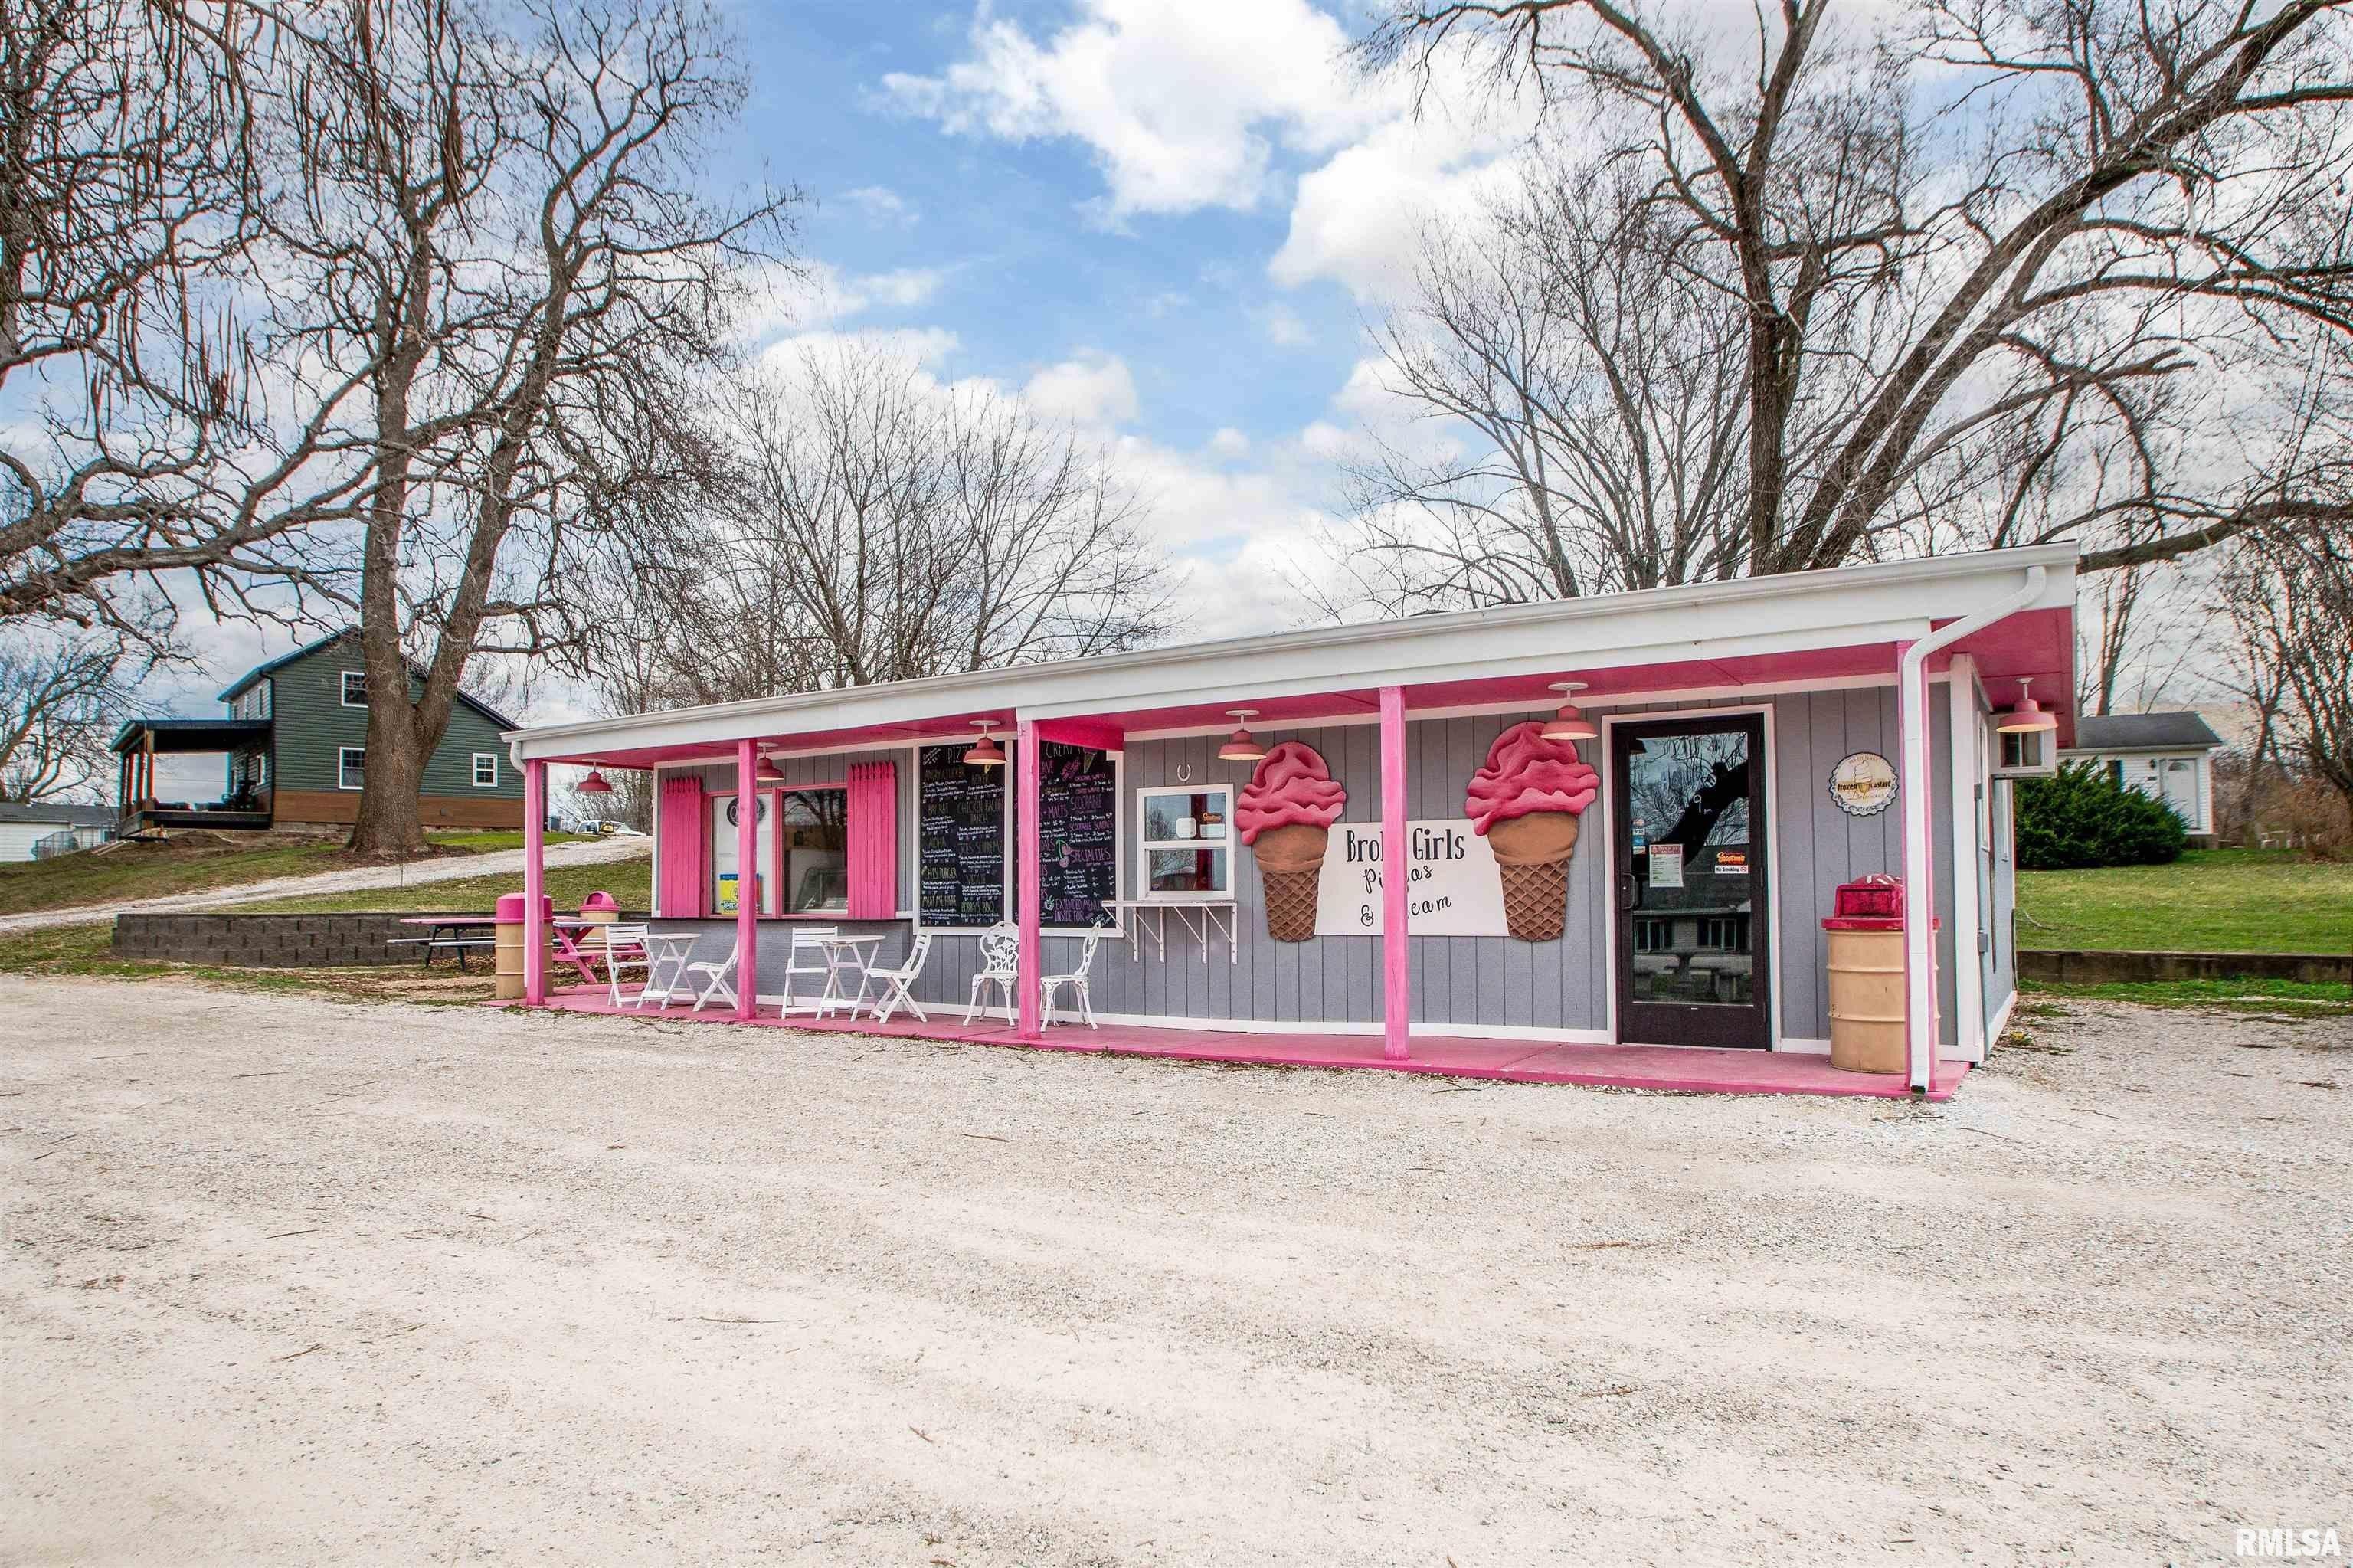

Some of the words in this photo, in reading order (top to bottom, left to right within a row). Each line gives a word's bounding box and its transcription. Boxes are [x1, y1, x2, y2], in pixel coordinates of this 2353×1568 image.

[947, 746, 973, 764] PIZ
[1347, 830, 1383, 862] Bro
[1412, 827, 1465, 861] Girls
[1363, 865, 1433, 894] Pias
[1361, 904, 1374, 927] &
[1408, 895, 1453, 919] eam
